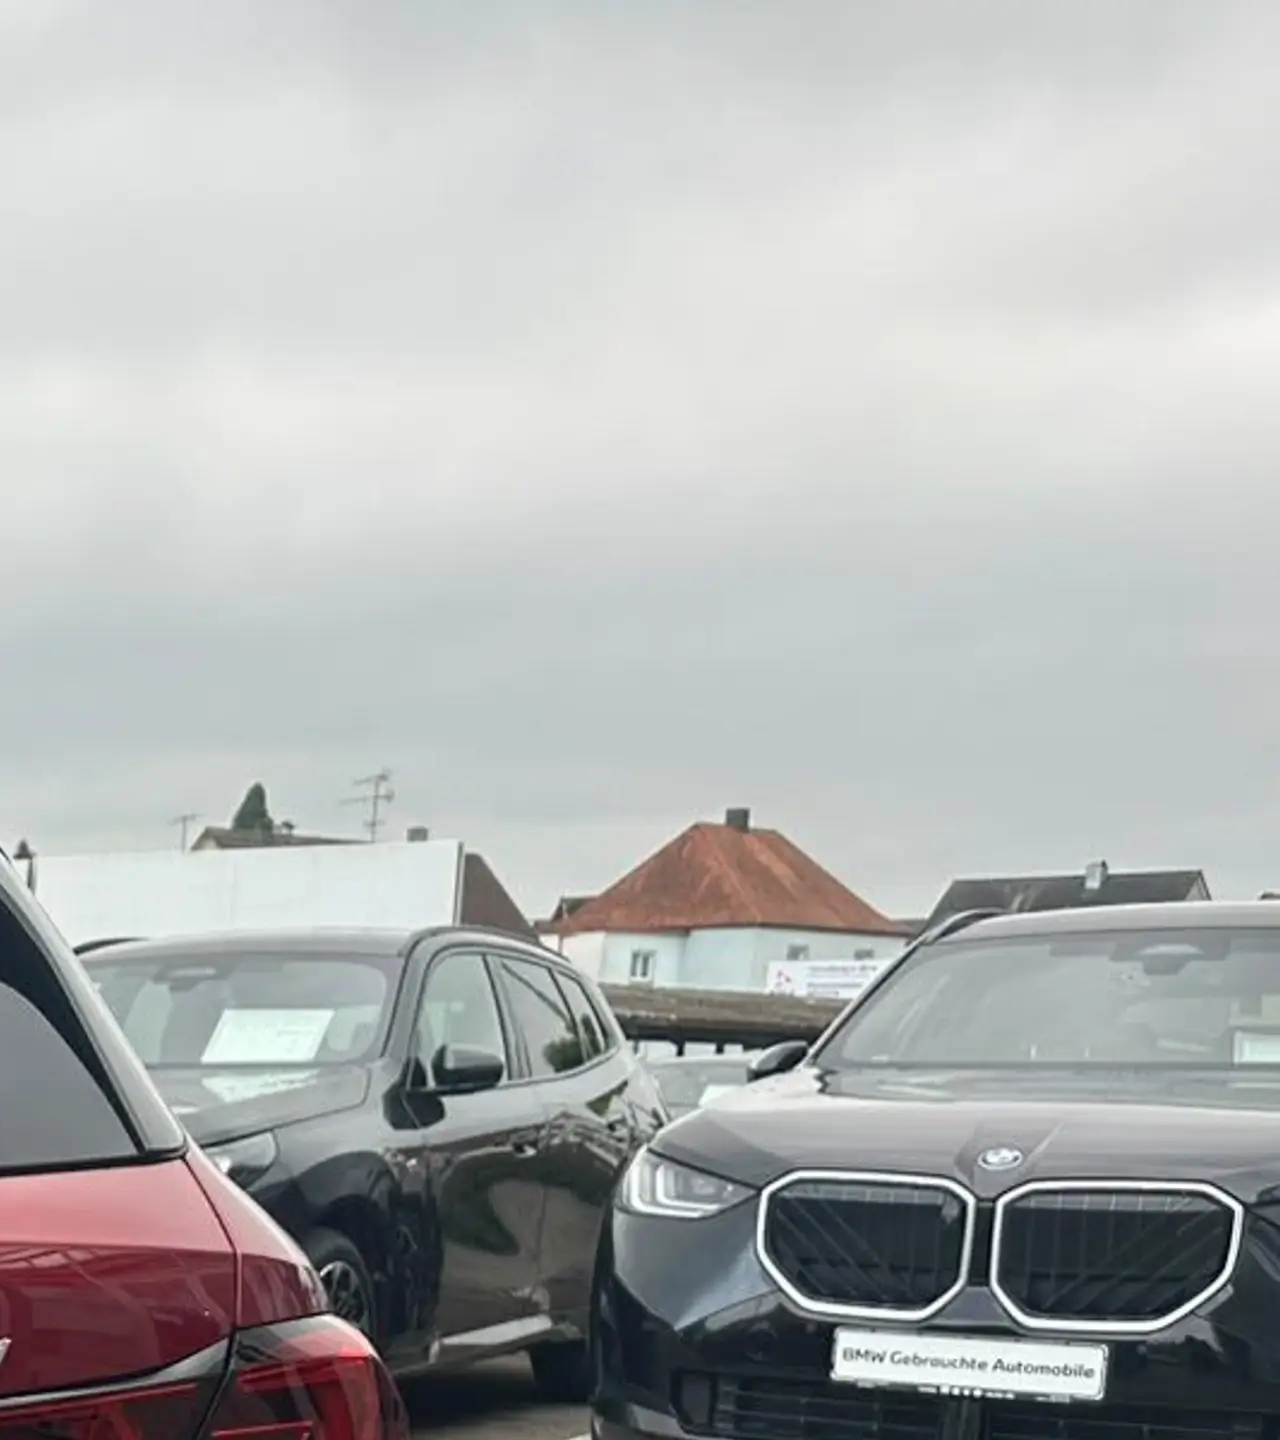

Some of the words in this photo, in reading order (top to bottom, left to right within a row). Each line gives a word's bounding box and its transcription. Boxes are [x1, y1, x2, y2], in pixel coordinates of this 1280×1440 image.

[842, 1346, 886, 1364] BMW
[890, 1351, 989, 1371] Gebrauchte
[992, 1357, 1096, 1379] Automobile
